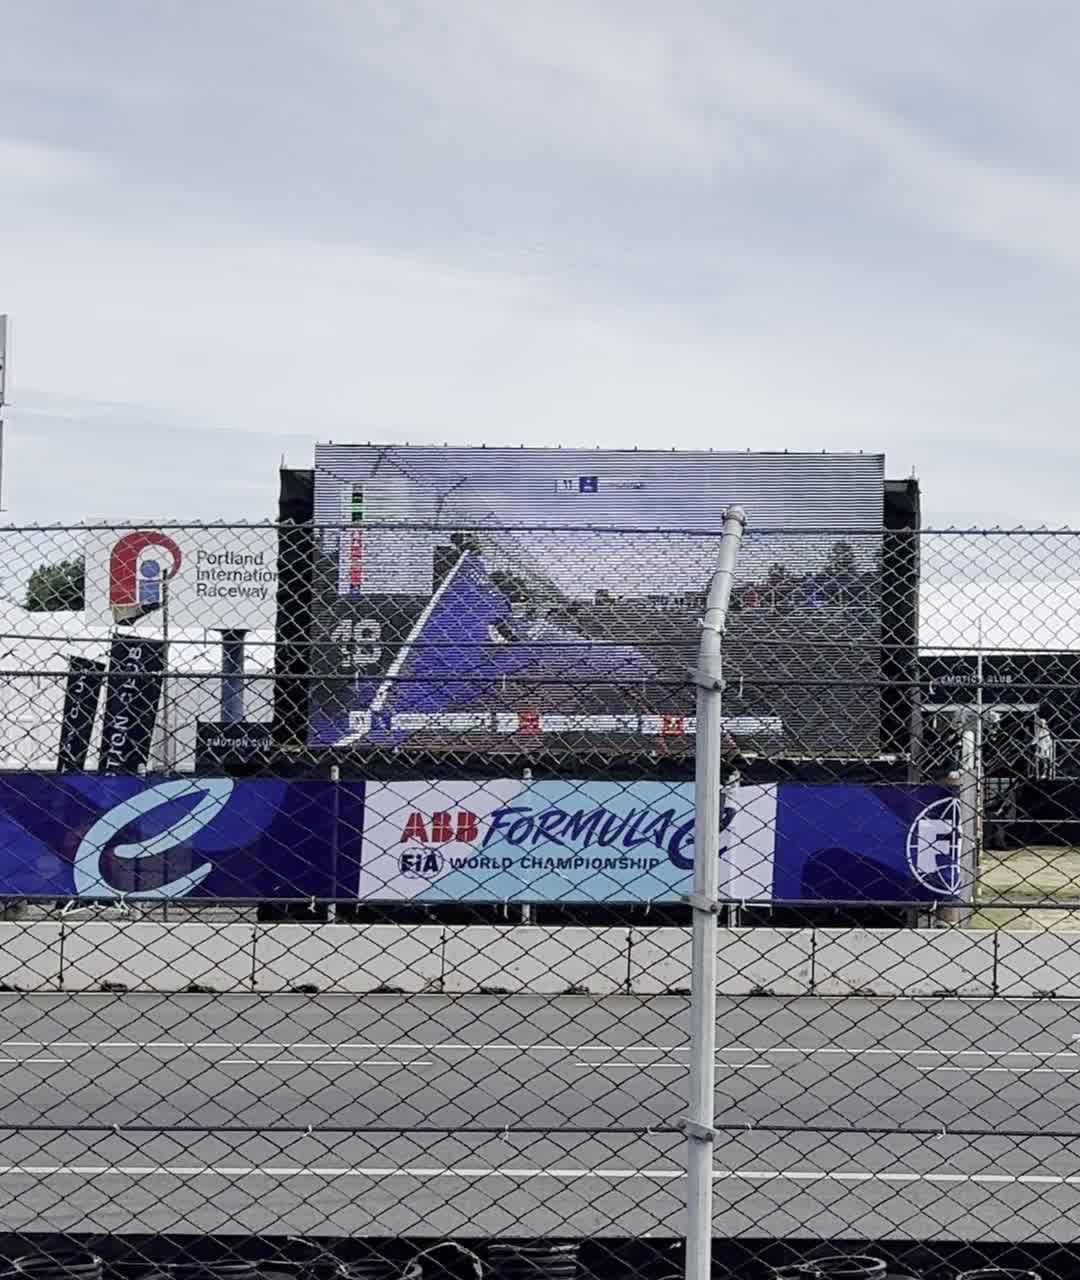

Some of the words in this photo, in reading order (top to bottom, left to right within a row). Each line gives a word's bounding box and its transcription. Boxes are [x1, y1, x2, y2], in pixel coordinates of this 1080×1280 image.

[197, 550, 264, 565] Portland
[196, 583, 268, 600] Raceway
[104, 715, 128, 777] TION
[400, 812, 478, 843] ABB
[482, 806, 675, 848] FORMULA
[450, 857, 513, 869] WORLD
[520, 857, 660, 870] CHAMPIONSHIP
